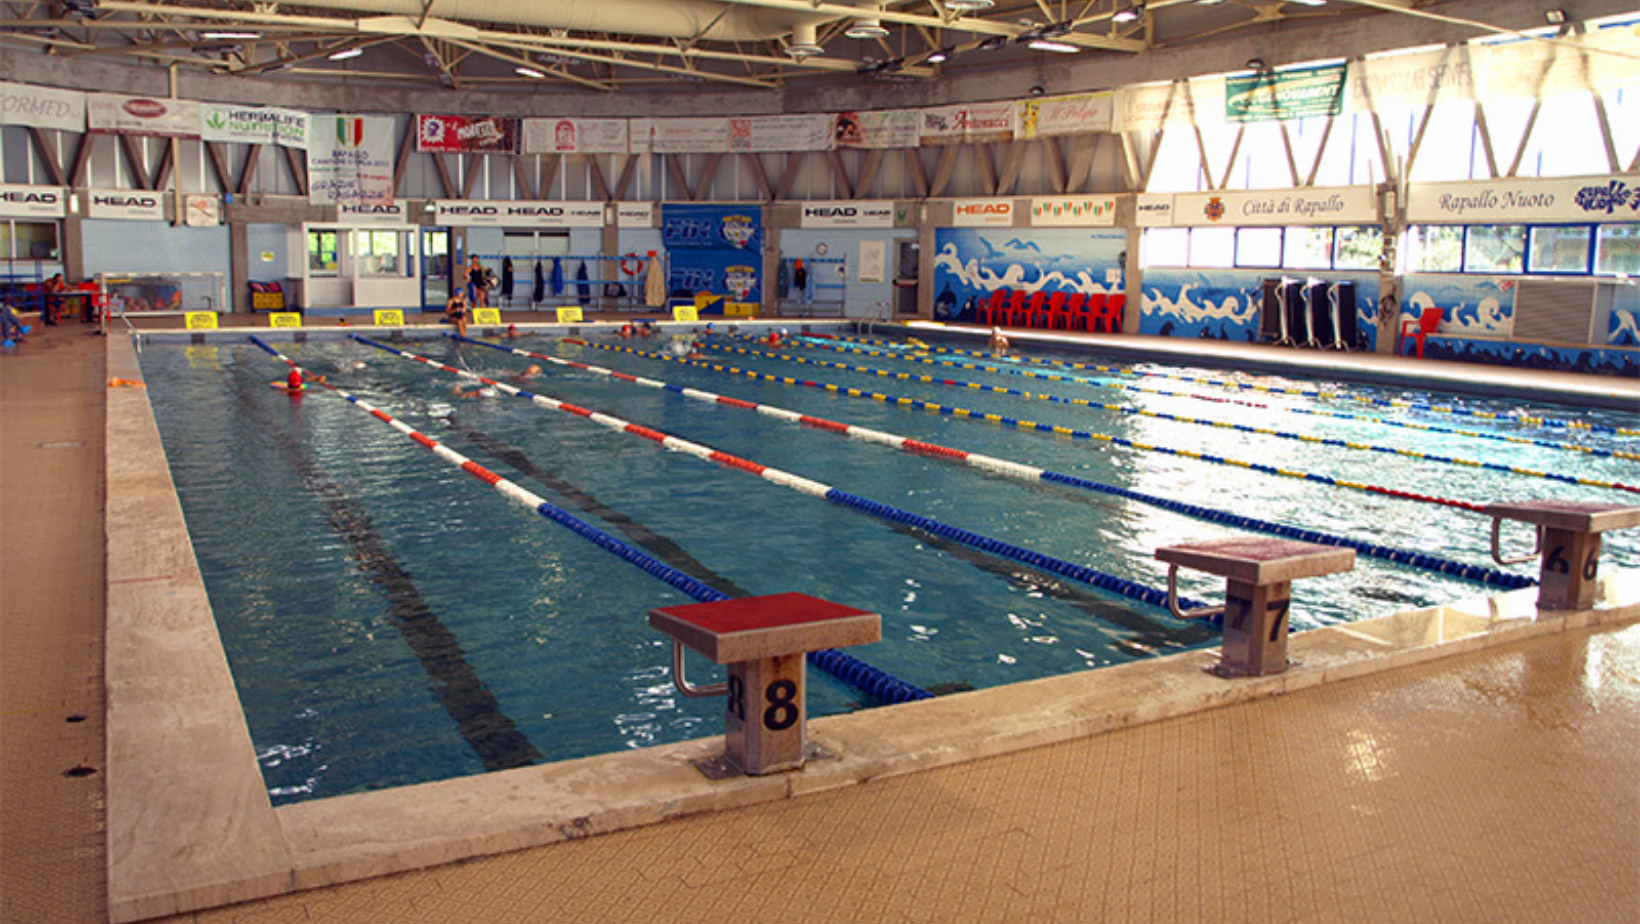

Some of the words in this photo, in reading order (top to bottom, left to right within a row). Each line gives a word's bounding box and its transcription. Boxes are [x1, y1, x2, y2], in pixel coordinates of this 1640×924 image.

[93, 195, 157, 208] HEAD
[342, 205, 400, 214] HEAD
[957, 203, 1011, 215] HEAD
[1242, 199, 1275, 217] Città
[1277, 197, 1291, 214] di
[1294, 193, 1345, 217] Rapallo
[1438, 189, 1498, 215] Rapallo
[1501, 191, 1555, 209] Nuoto
[440, 206, 498, 215] HEAD
[508, 206, 564, 216] HEAD
[805, 207, 857, 217] HEAD
[1583, 547, 1599, 582] 6
[1267, 598, 1290, 642] 7
[763, 679, 799, 731] 8
